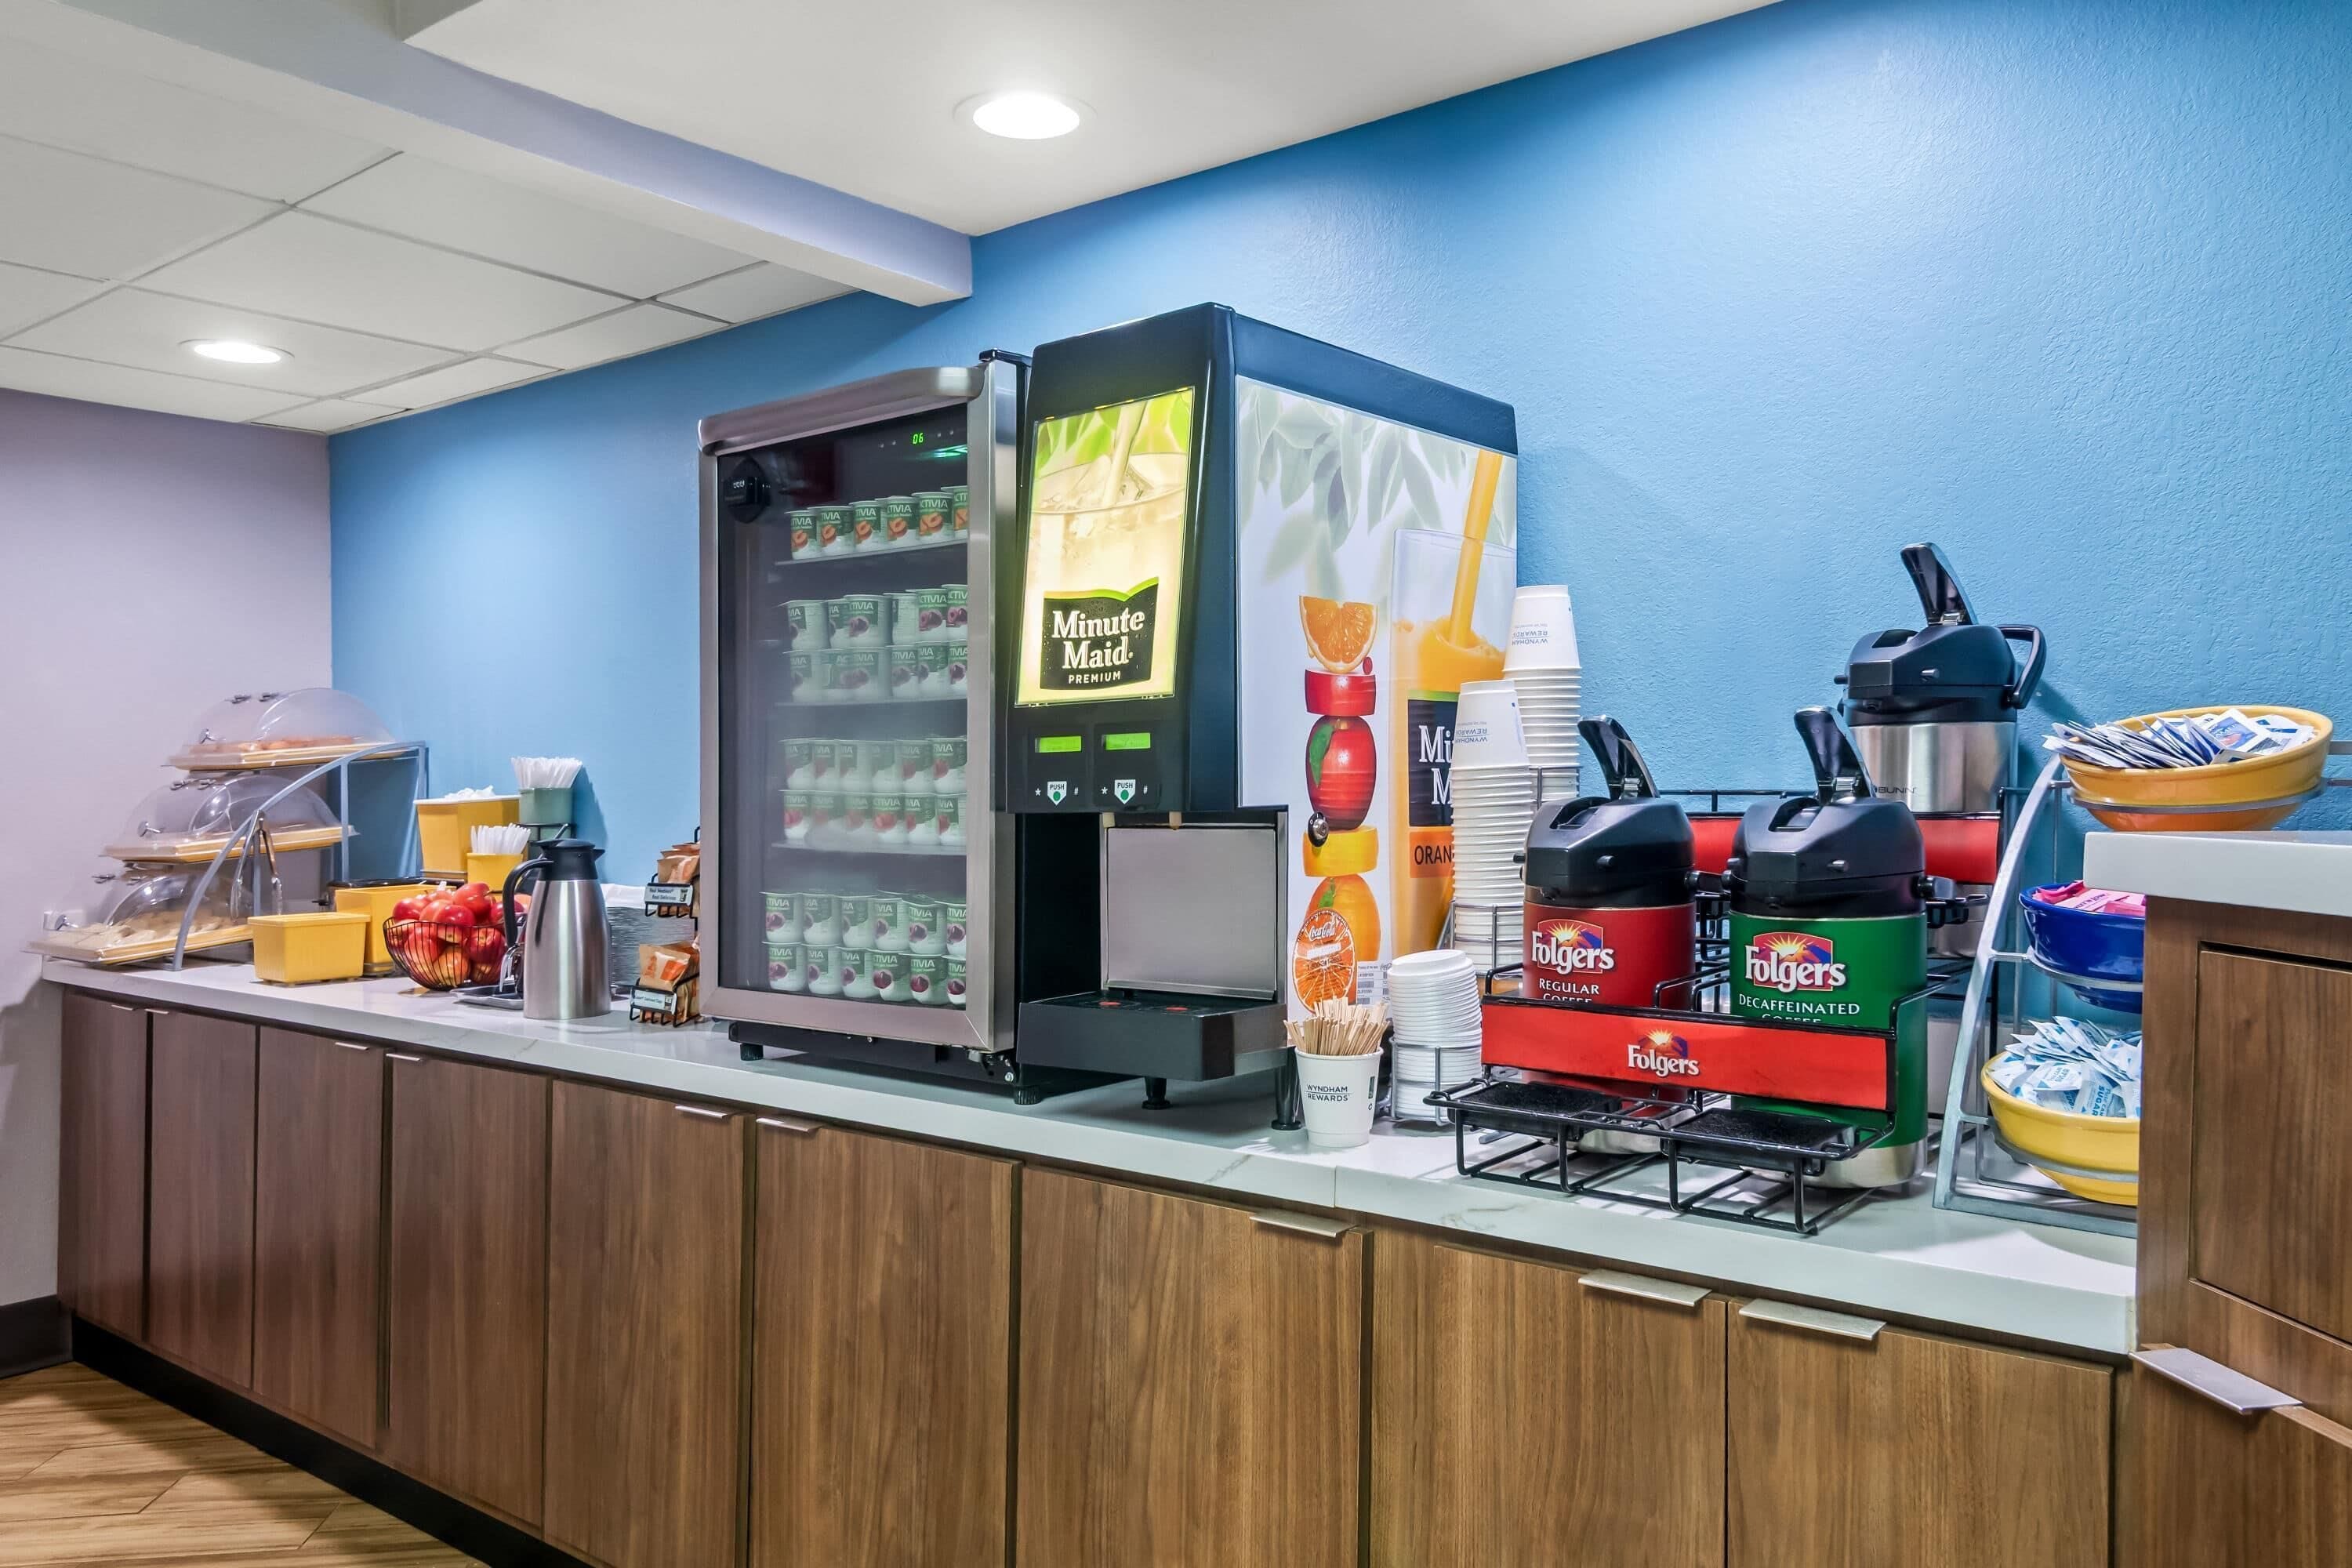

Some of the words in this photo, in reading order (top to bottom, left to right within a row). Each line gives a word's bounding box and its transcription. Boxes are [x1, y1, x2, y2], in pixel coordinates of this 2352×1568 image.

[913, 432, 924, 445] 06
[1051, 607, 1145, 638] Minute
[1069, 670, 1121, 684] PREMIUM
[1414, 845, 1452, 865] ORAN
[1531, 931, 1615, 975] Folgers
[1745, 945, 1847, 993] Folgers
[1539, 978, 1600, 995] REGULAR
[1739, 993, 1860, 1014] DECAFFEINATED
[1628, 1044, 1700, 1077] Folgers
[1307, 1084, 1348, 1093] WYNDHAM
[1307, 1093, 1348, 1102] REWARDS
